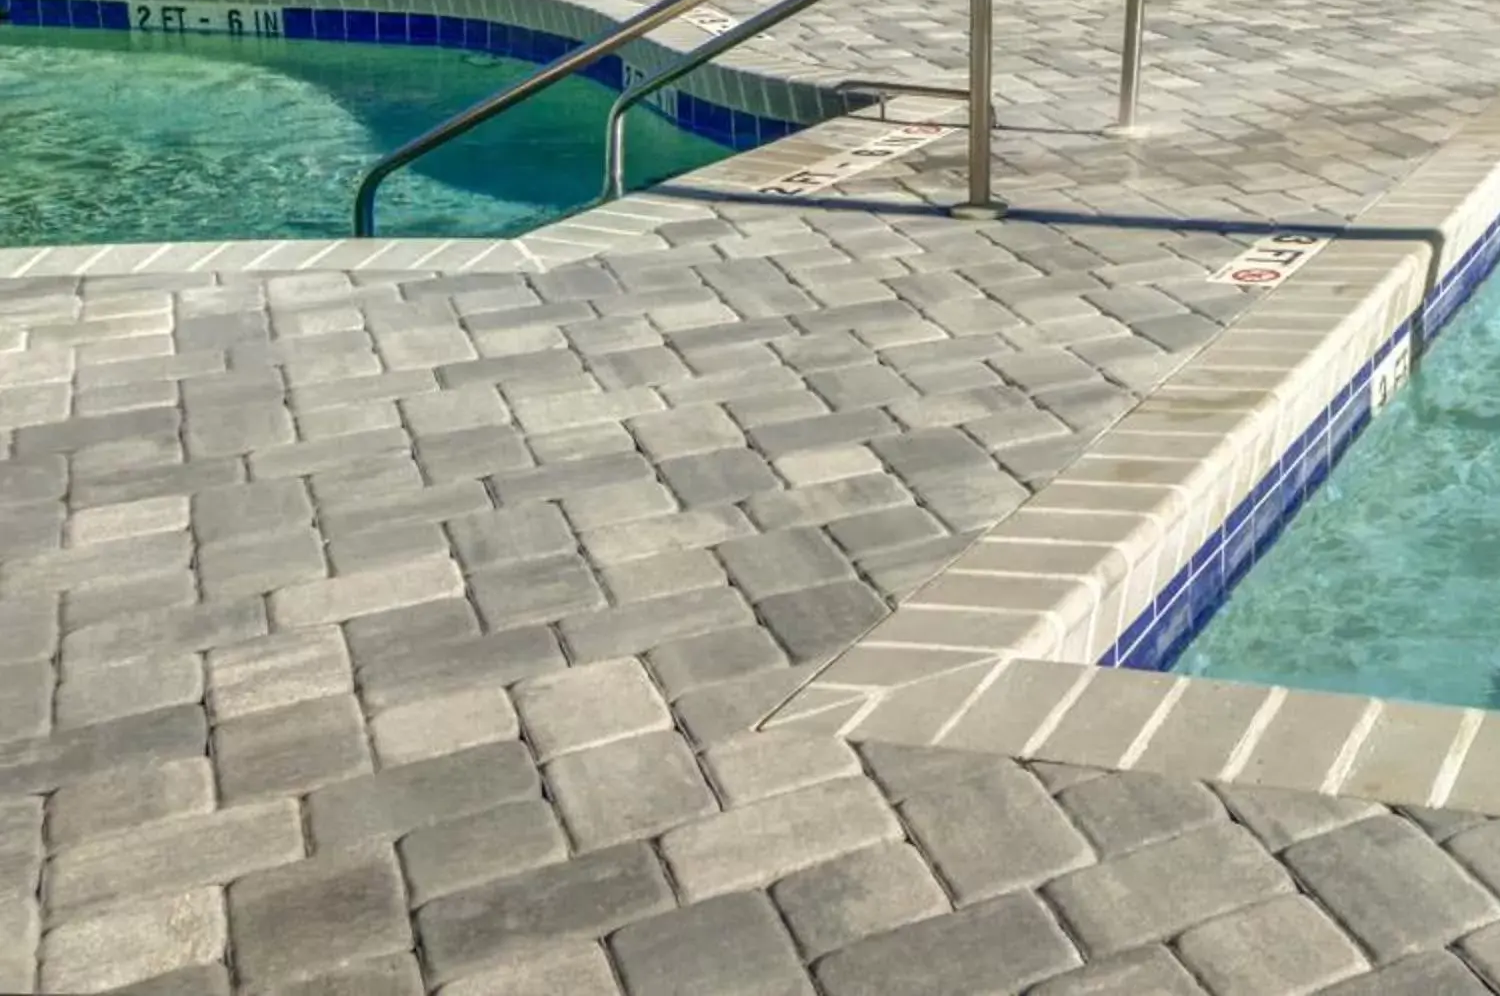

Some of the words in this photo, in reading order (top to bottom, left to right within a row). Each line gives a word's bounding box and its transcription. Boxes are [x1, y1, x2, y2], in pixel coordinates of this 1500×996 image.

[136, 5, 151, 31] 2
[161, 6, 187, 34] FT
[254, 10, 279, 37] IN
